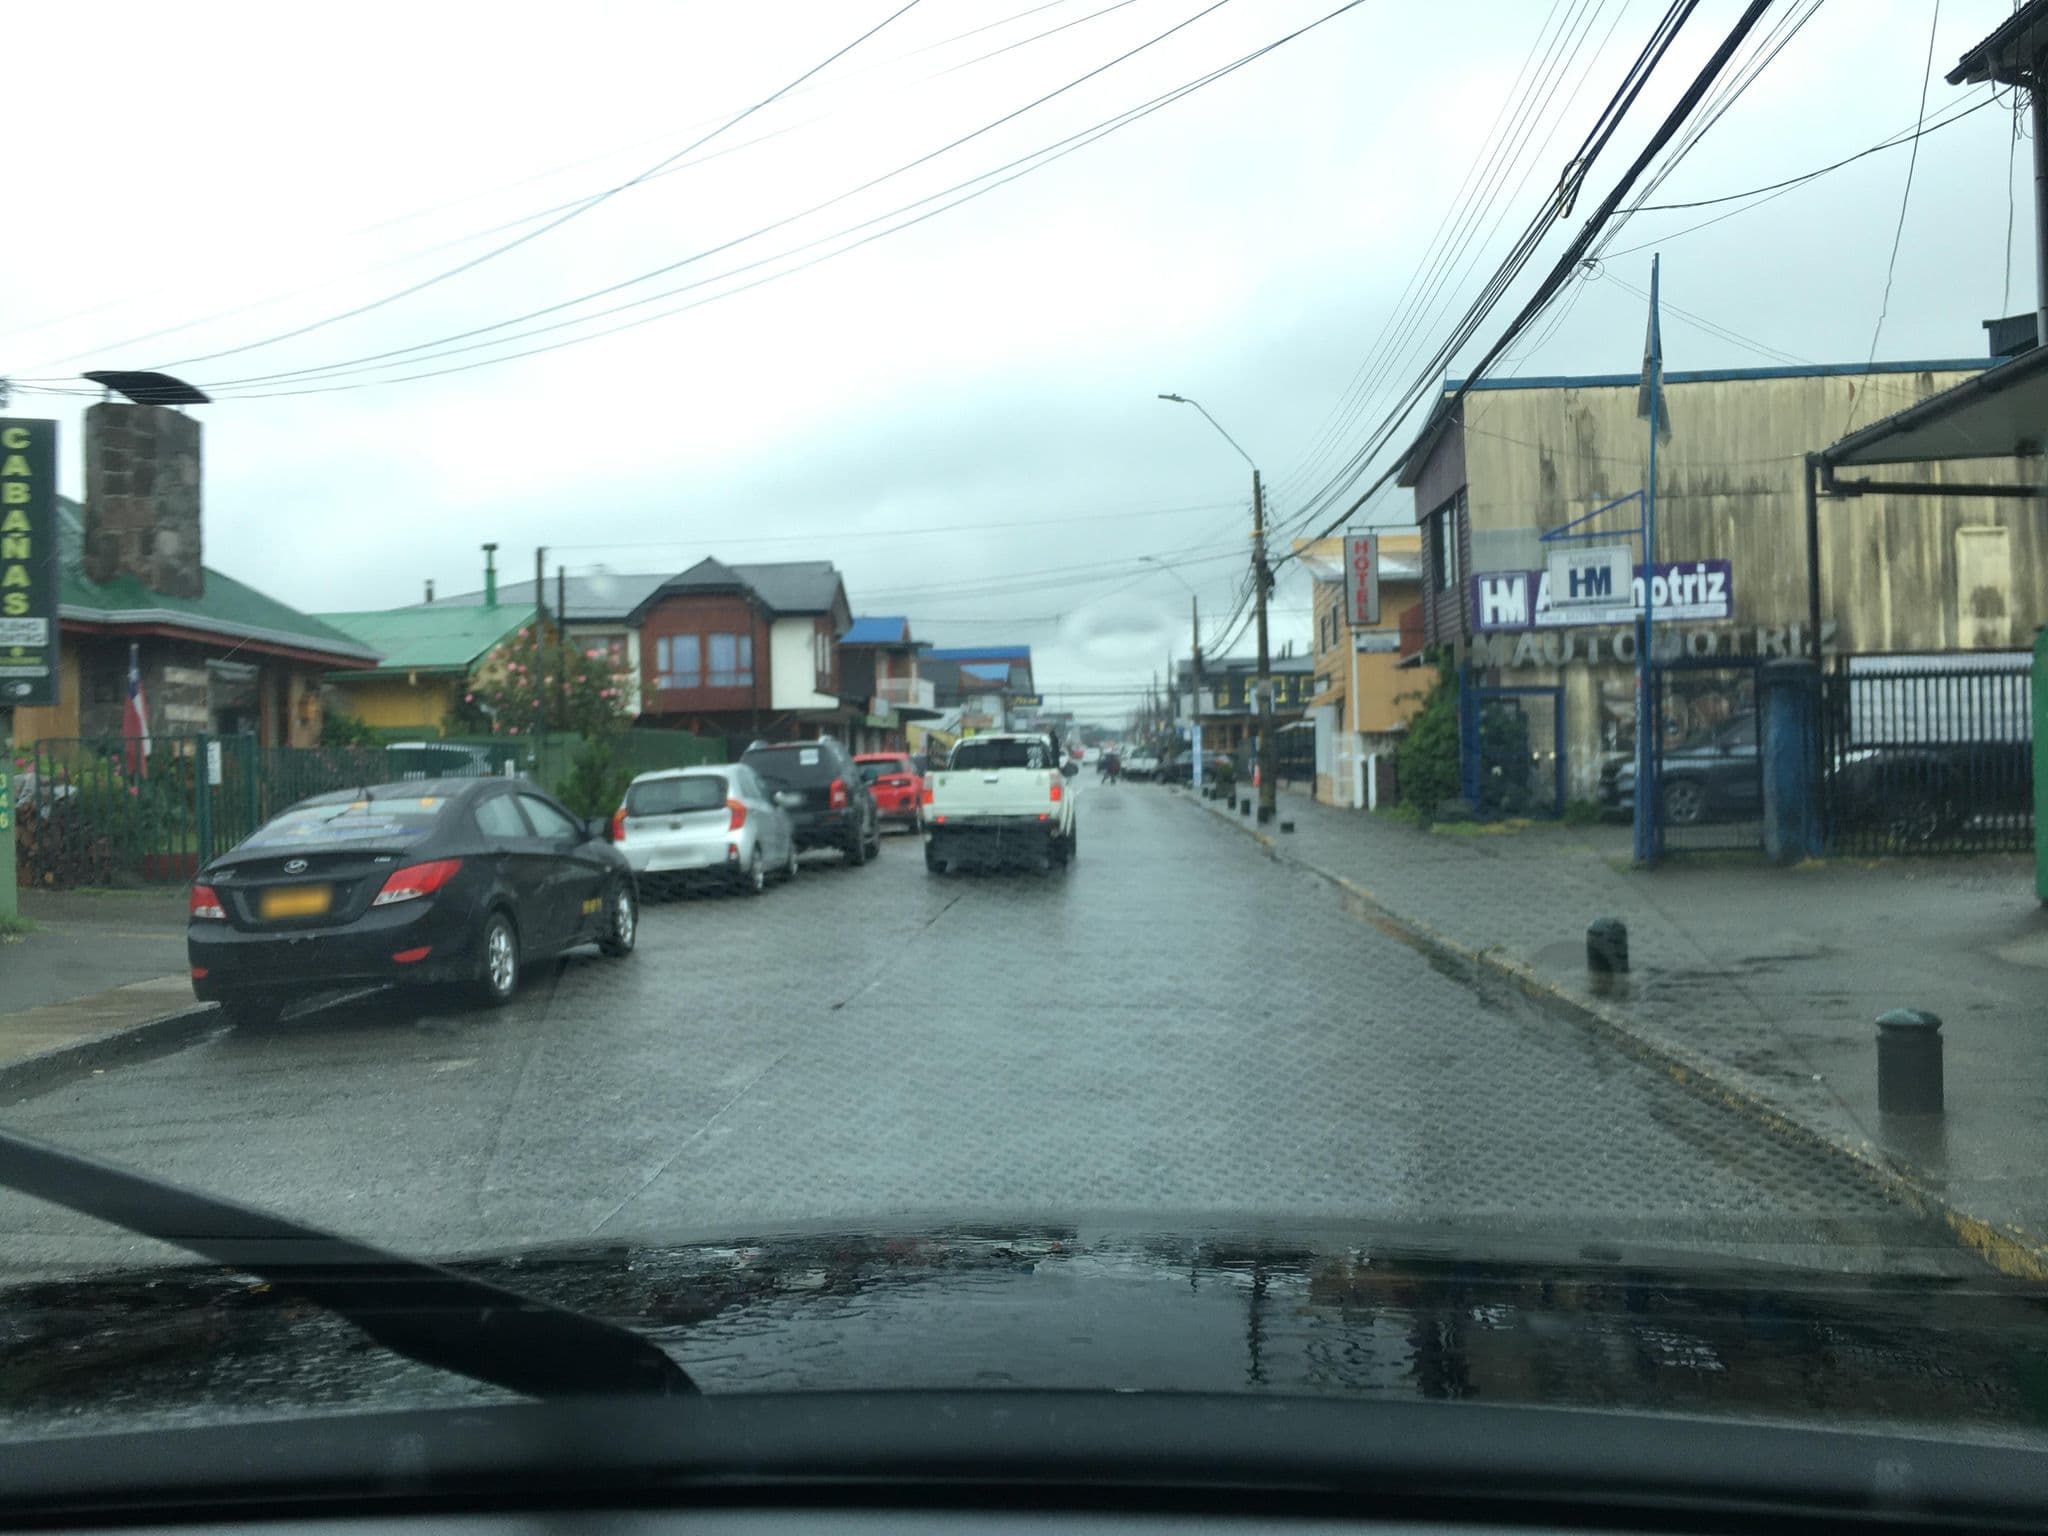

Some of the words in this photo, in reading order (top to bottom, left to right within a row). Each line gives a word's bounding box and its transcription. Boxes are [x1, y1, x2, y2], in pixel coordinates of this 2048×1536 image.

[1, 427, 32, 615] CABAÑAS
[1353, 540, 1370, 620] HOTEL
[1482, 577, 1526, 624] HM
[1567, 566, 1612, 598] HM
